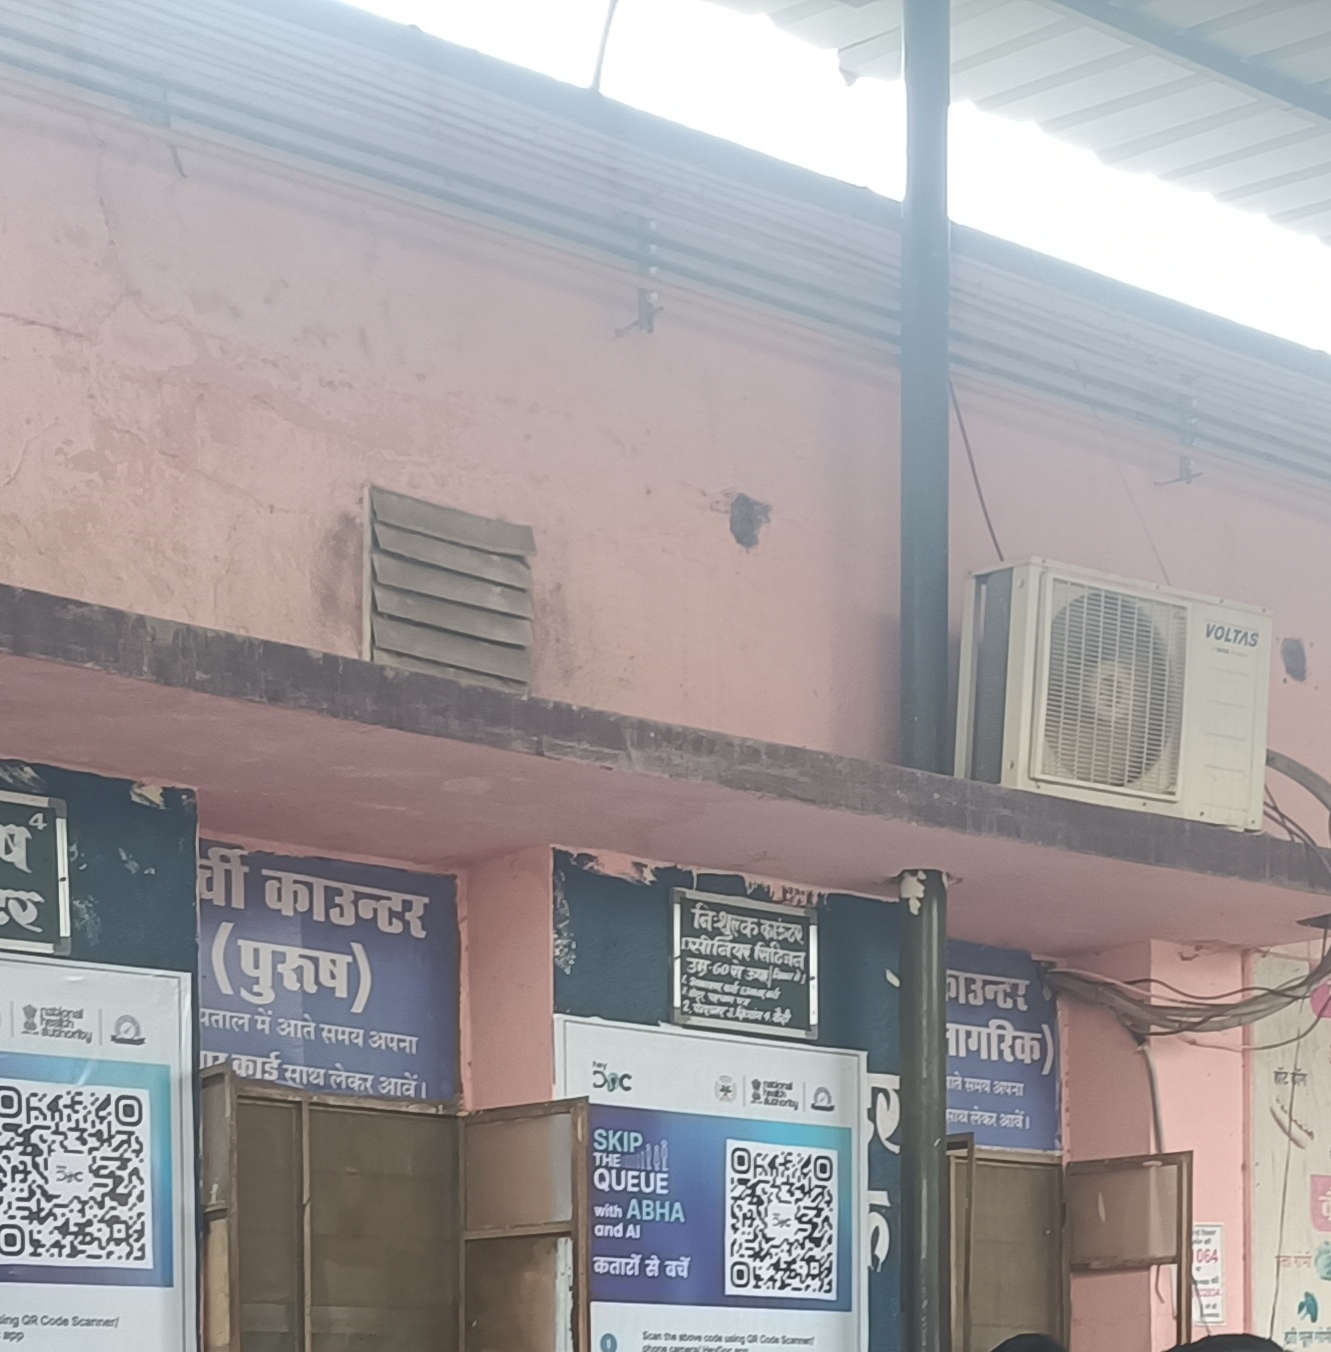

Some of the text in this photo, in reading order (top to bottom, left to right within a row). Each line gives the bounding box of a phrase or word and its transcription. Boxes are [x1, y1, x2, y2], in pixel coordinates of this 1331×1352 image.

[1206, 624, 1259, 647] VOLTAS
[29, 813, 46, 830] 4
[199, 847, 429, 938] र्ची काउन्टर
[255, 1008, 273, 1034] में
[277, 1014, 316, 1040] आते
[319, 1023, 365, 1047] समय
[369, 1031, 419, 1055] अपना
[232, 1051, 282, 1081] कार्ड
[283, 1064, 326, 1087] साथ
[328, 1063, 374, 1093] लेकर
[593, 1129, 643, 1153] SKIP
[593, 1152, 621, 1167] THE
[593, 1169, 669, 1194] QUEUE
[594, 1199, 685, 1222] with ABHA
[594, 1222, 640, 1239] and AI
[593, 1253, 642, 1277] कतारों
[645, 1255, 661, 1277] से
[1196, 1247, 1219, 1264] 064
[22, 1314, 38, 1326] QR
[40, 1315, 69, 1327] Code
[3, 1331, 24, 1343] app
[642, 1331, 662, 1342] Scan
[664, 1332, 677, 1342] the
[679, 1333, 702, 1343] above
[704, 1334, 723, 1343] code
[724, 1333, 745, 1345] using
[759, 1334, 780, 1345] Code
